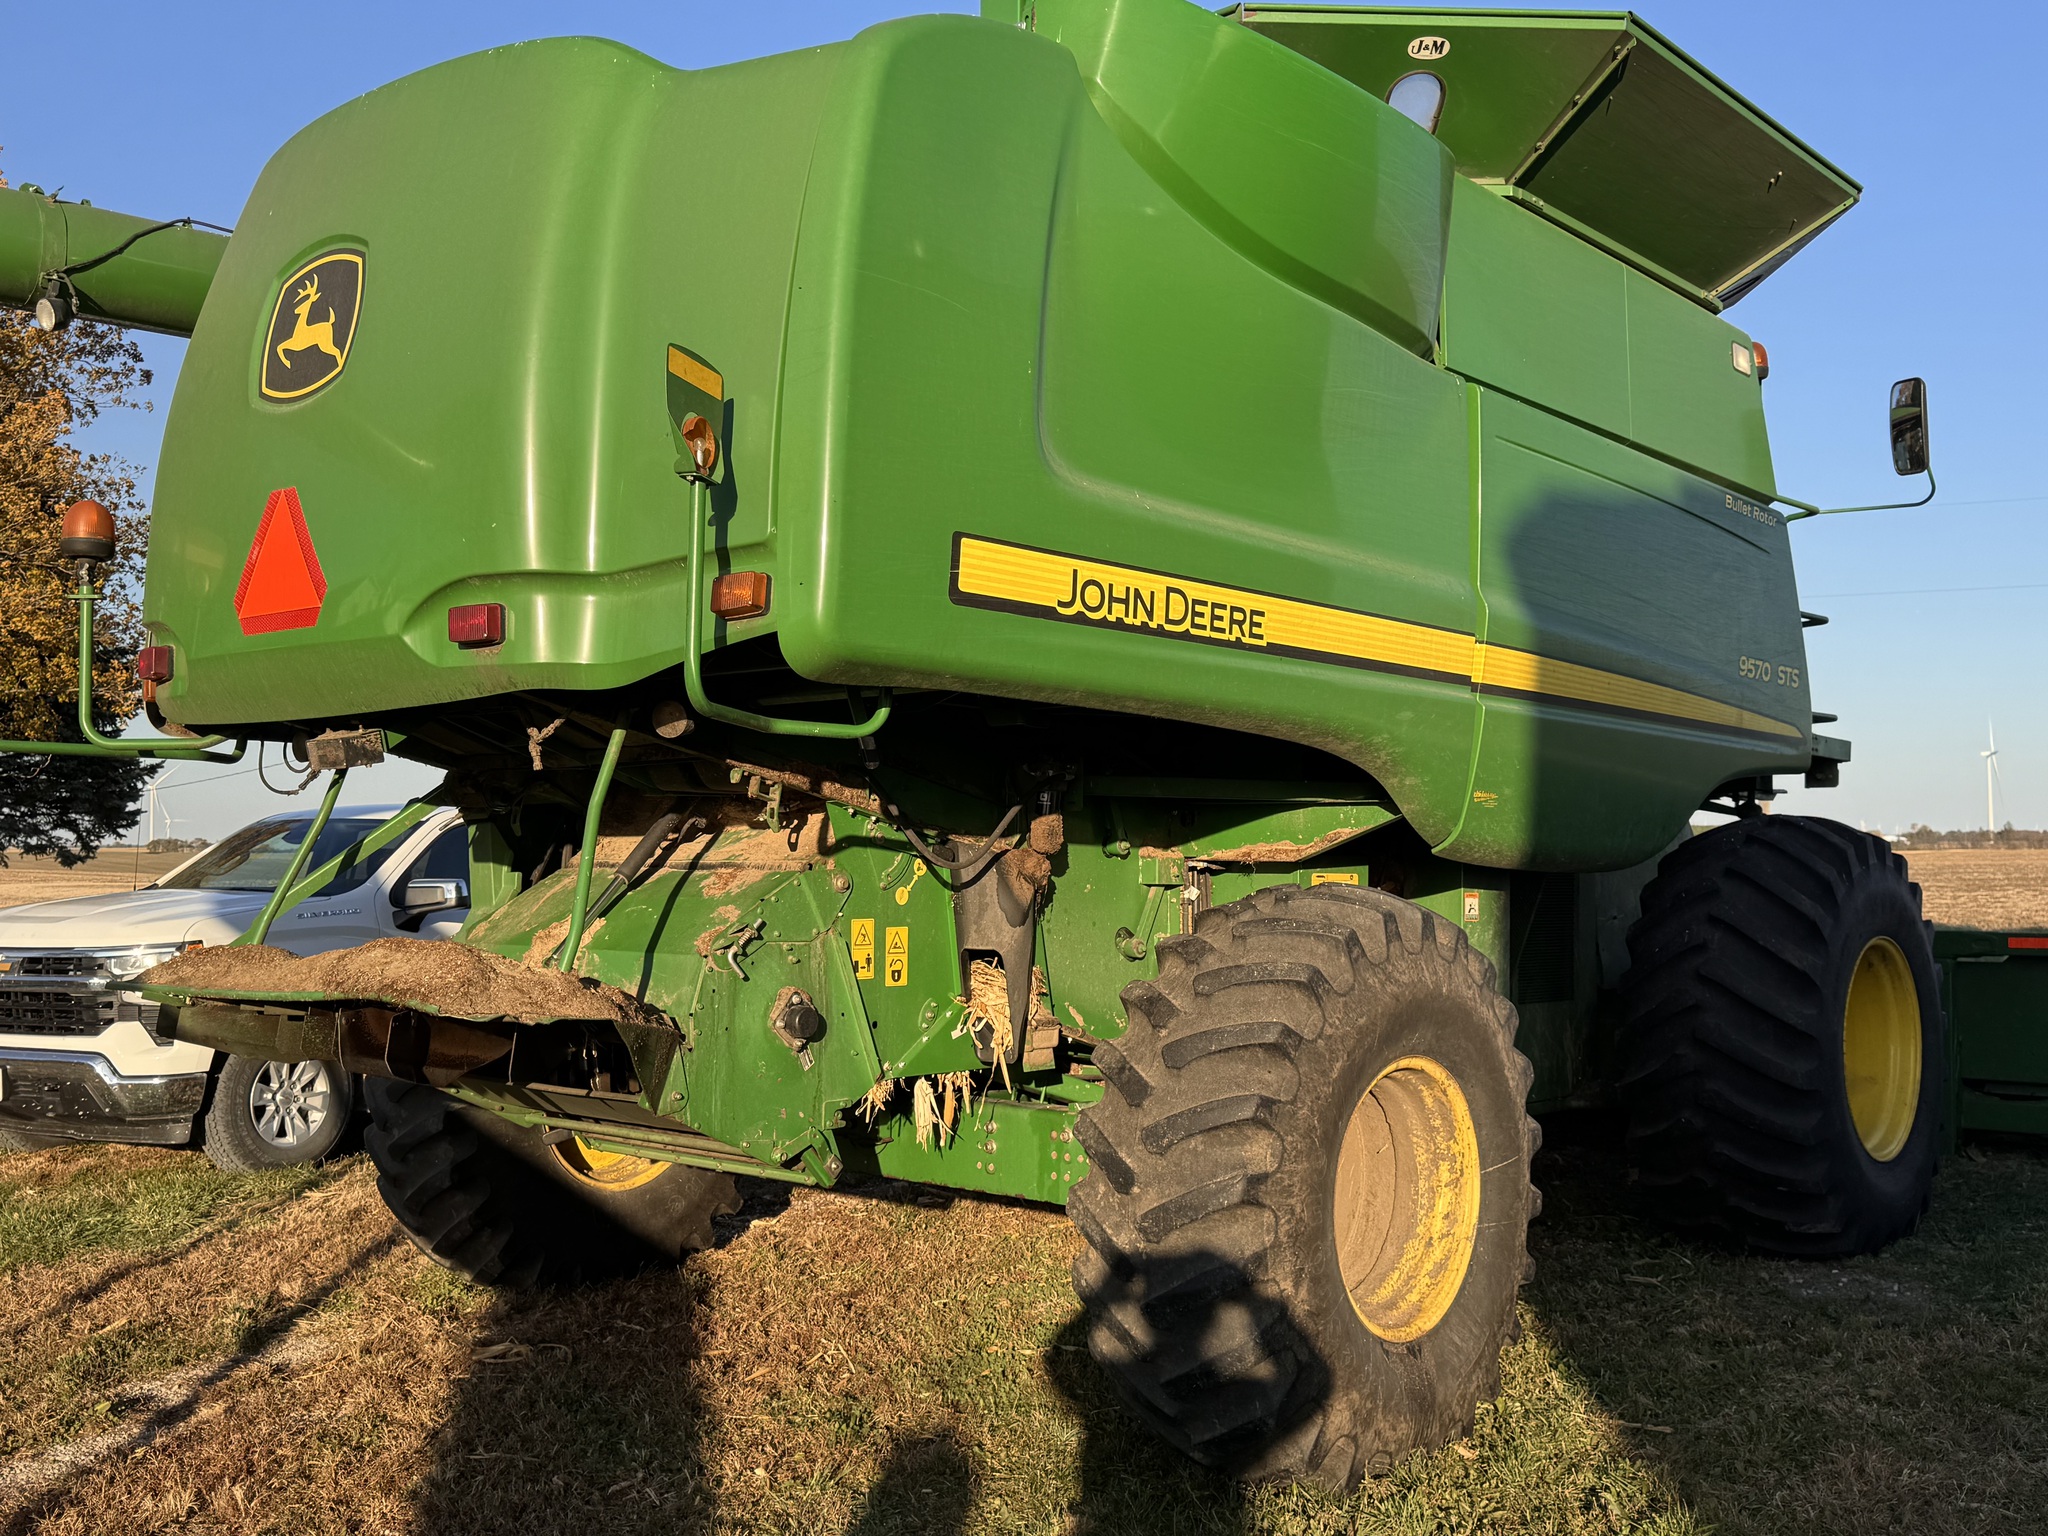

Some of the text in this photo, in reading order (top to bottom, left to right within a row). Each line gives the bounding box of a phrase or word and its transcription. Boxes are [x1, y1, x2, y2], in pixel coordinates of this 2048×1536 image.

[1411, 39, 1446, 55] J&M
[1725, 494, 1777, 527] Bullet Rotor
[1057, 568, 1265, 641] JOHN DEERE
[1739, 655, 1800, 688] 9570 STS
[296, 907, 362, 919] SILVERADO
